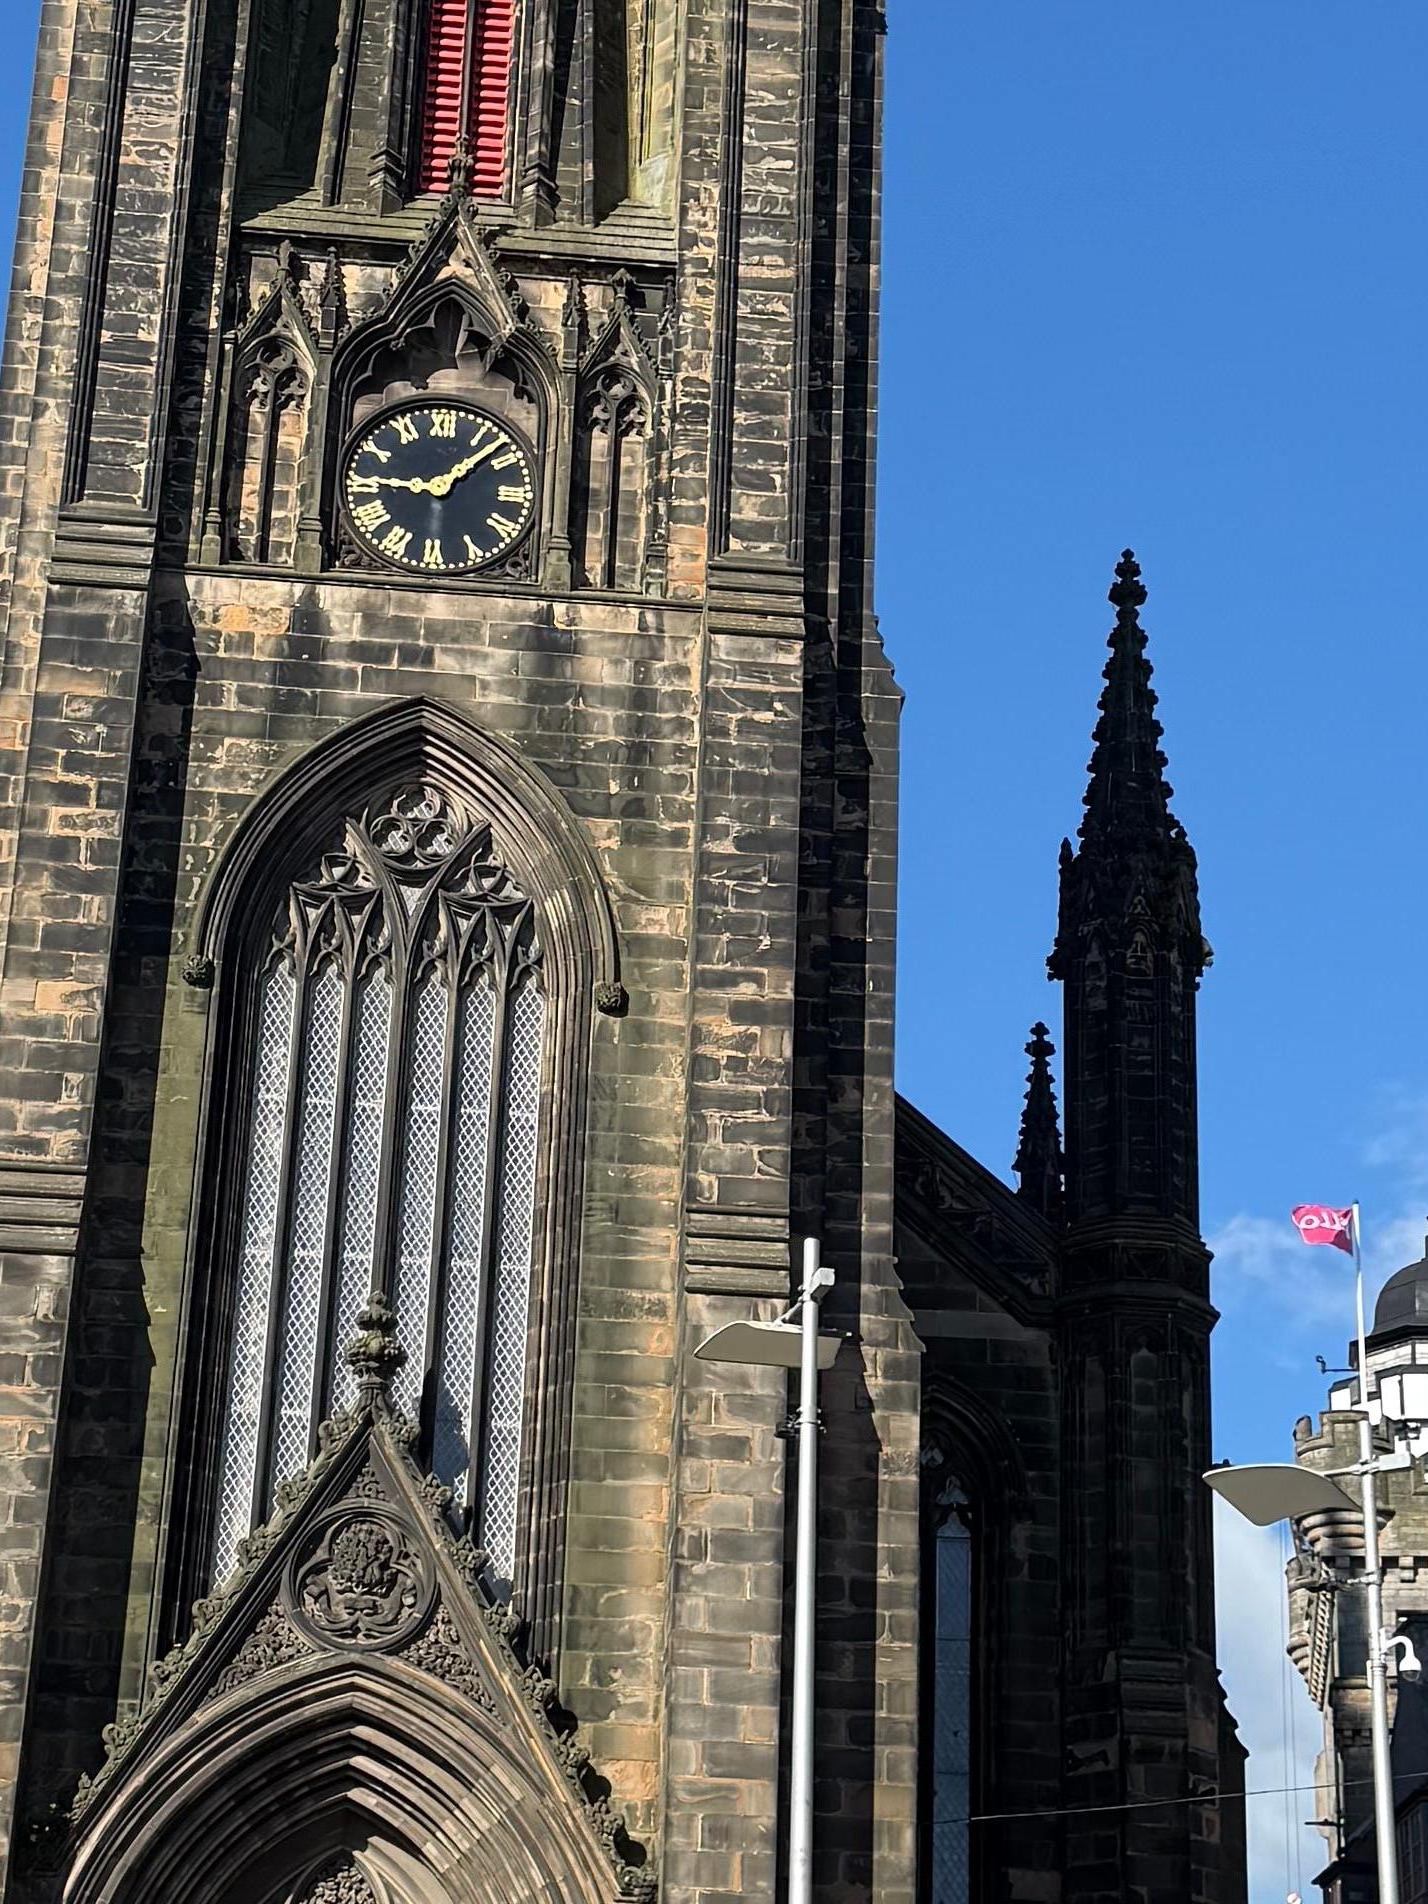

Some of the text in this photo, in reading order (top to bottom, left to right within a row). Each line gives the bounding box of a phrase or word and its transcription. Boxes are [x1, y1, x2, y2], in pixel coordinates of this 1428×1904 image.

[389, 414, 420, 444] XI
[429, 412, 457, 438] XII
[361, 440, 392, 464] X
[491, 452, 518, 471] II
[497, 484, 526, 503] III
[378, 525, 413, 559] VII
[423, 538, 444, 564] VI
[463, 534, 484, 560] V
